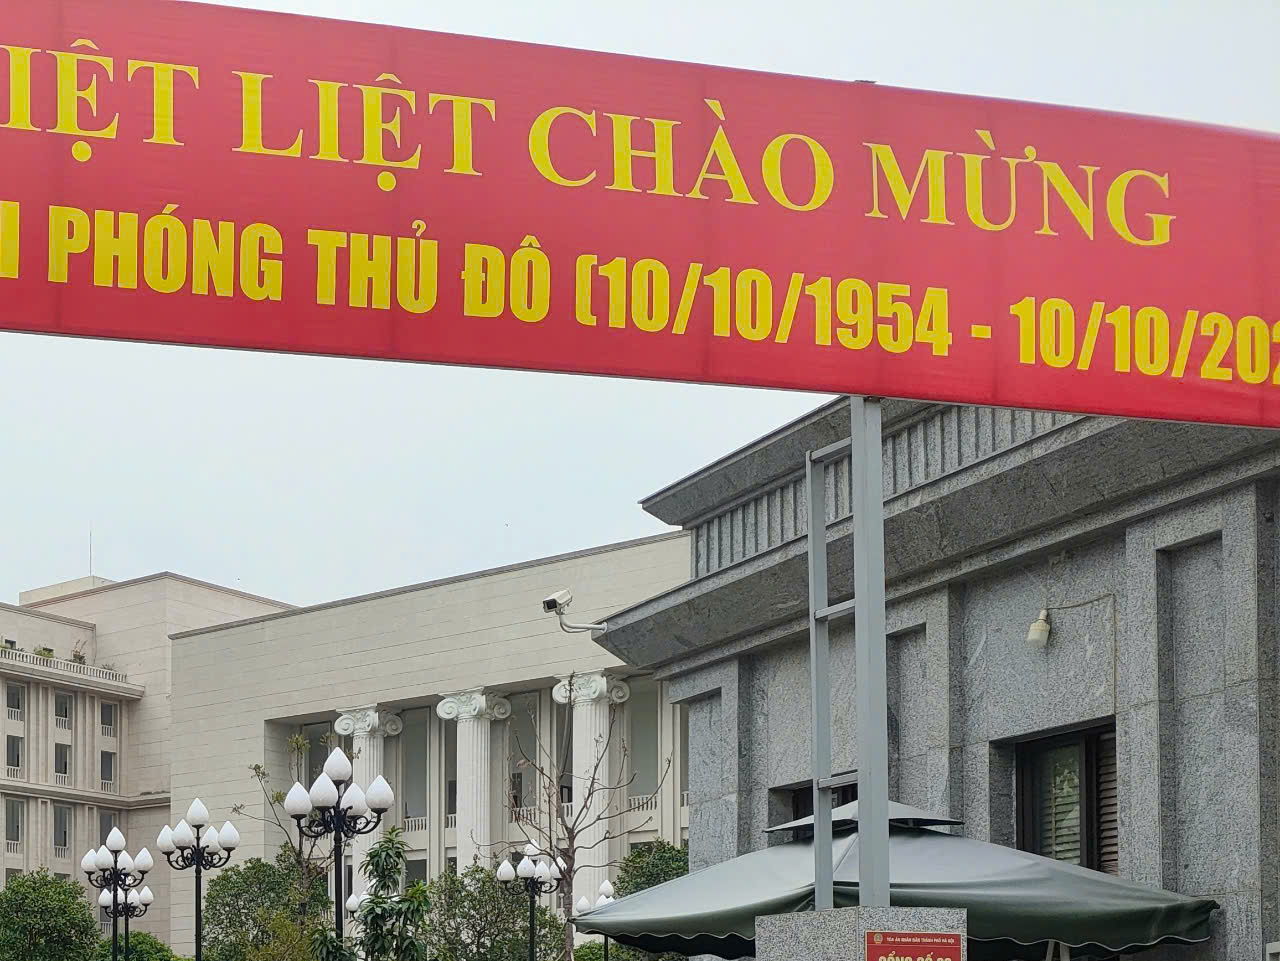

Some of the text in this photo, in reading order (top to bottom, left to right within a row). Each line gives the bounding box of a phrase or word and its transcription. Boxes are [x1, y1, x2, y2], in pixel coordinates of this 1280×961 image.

[232, 71, 497, 191] LIỆT
[528, 99, 836, 211] CHÀO
[863, 130, 1176, 246] MỪNG
[47, 205, 283, 301] PHÓNG
[307, 219, 439, 314] THỦ
[461, 234, 551, 323] ĐÔ
[575, 254, 953, 357] (10/10/1954
[1009, 296, 1280, 385] 10/10/20
